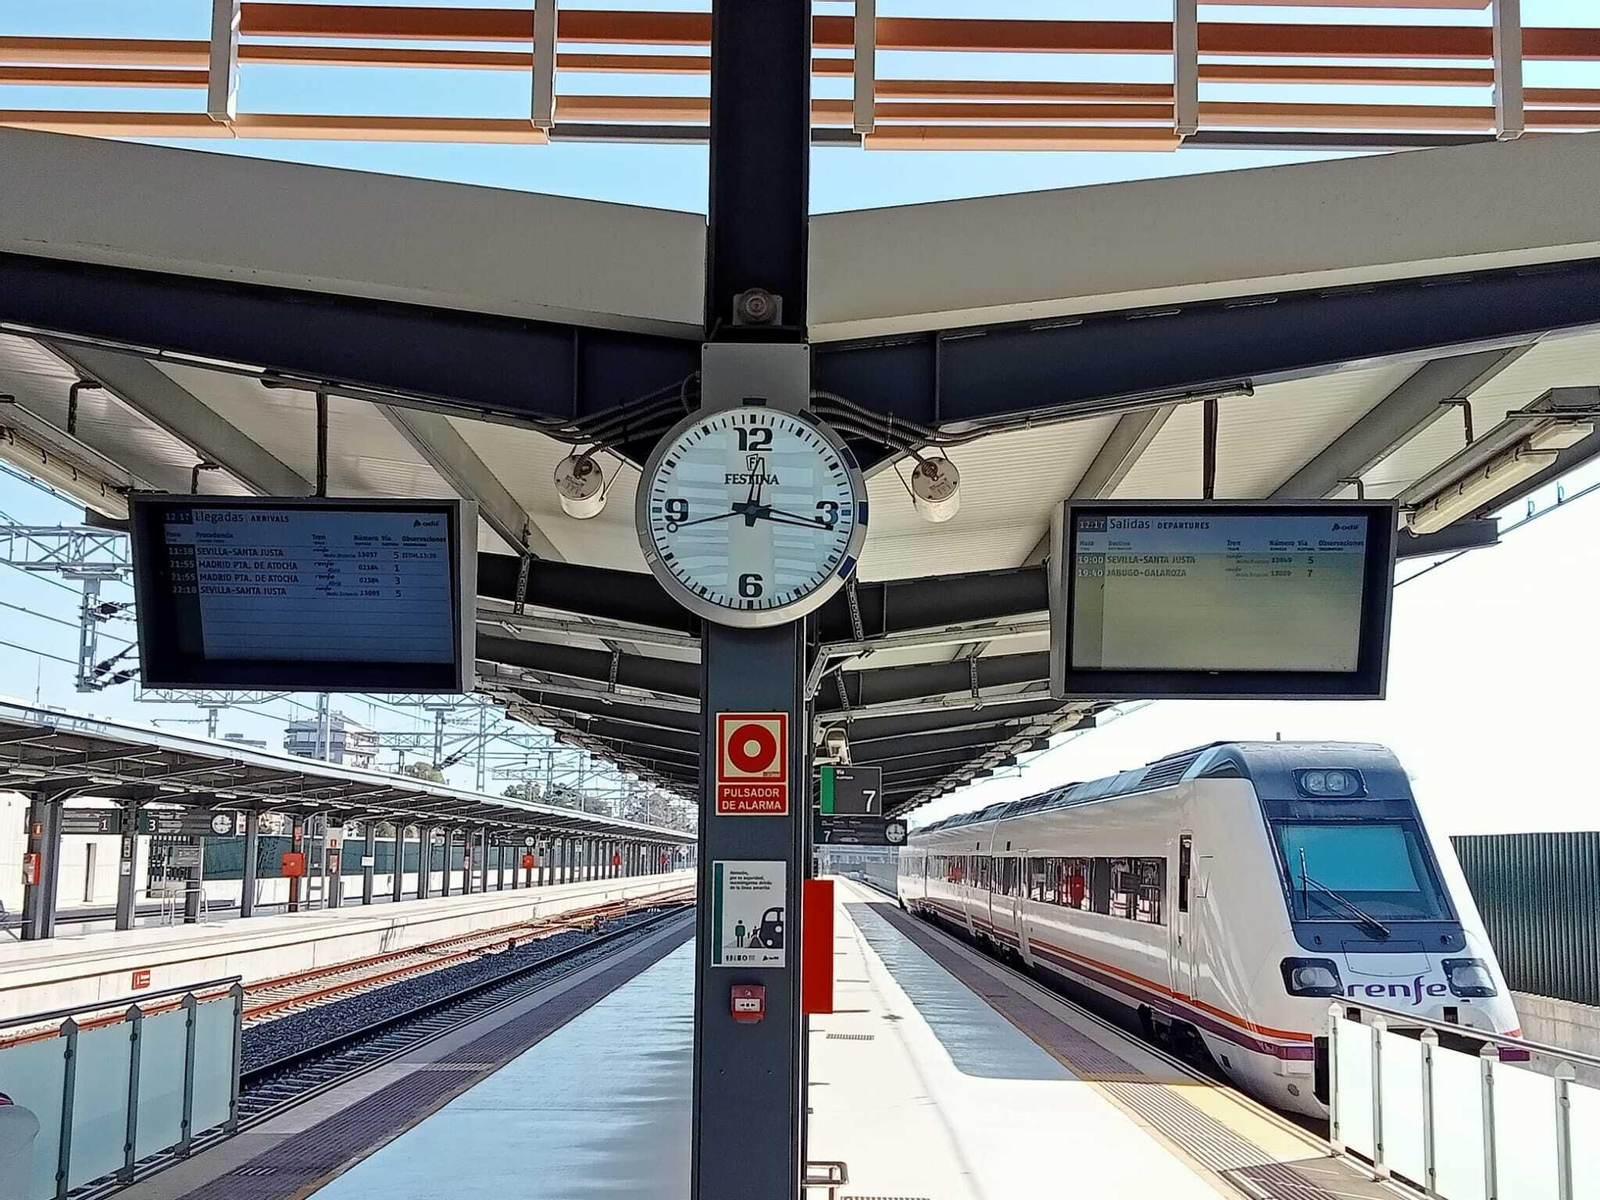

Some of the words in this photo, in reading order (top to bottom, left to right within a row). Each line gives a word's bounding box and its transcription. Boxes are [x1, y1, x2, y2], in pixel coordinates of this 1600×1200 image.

[734, 427, 773, 452] 12
[724, 473, 780, 485] FESTINA
[665, 498, 689, 522] 9
[815, 500, 839, 525] 3
[195, 511, 244, 524] Llegadas
[250, 515, 289, 523] ARRIVALS
[1109, 518, 1150, 529] Salidas
[1157, 521, 1210, 530] DEPARTURES
[196, 547, 257, 557] SEVILLA-SANTA
[259, 548, 284, 557] JUSTA
[393, 551, 400, 560] 5
[1106, 555, 1169, 564] SEVILLA-SANTA
[1171, 555, 1196, 564] JUSTA
[1308, 556, 1314, 565] 5
[198, 560, 231, 569] MADRID
[234, 561, 251, 570] PTA.
[254, 561, 265, 570] DE
[267, 562, 298, 570] ATOCHA
[394, 564, 400, 572] 1
[1106, 568, 1187, 577] JABUGO-GALAROZA
[1307, 569, 1313, 578] 7
[200, 573, 232, 582] MADRID
[235, 574, 252, 582] PTA.
[255, 574, 266, 583] DE
[268, 574, 299, 583] ATOCHA
[394, 576, 401, 585] 3
[738, 573, 763, 598] 6
[200, 586, 261, 595] SEVILLA-SANTA
[262, 587, 287, 596] JUSTA
[396, 589, 402, 598] 5
[723, 787, 780, 798] PULSADOR
[721, 800, 737, 810] DE
[738, 800, 782, 810] ALARMA
[862, 789, 877, 813] 7
[101, 819, 109, 831] 1
[148, 819, 156, 831] 3
[823, 830, 832, 843] 7
[1346, 974, 1448, 1006] renfe
